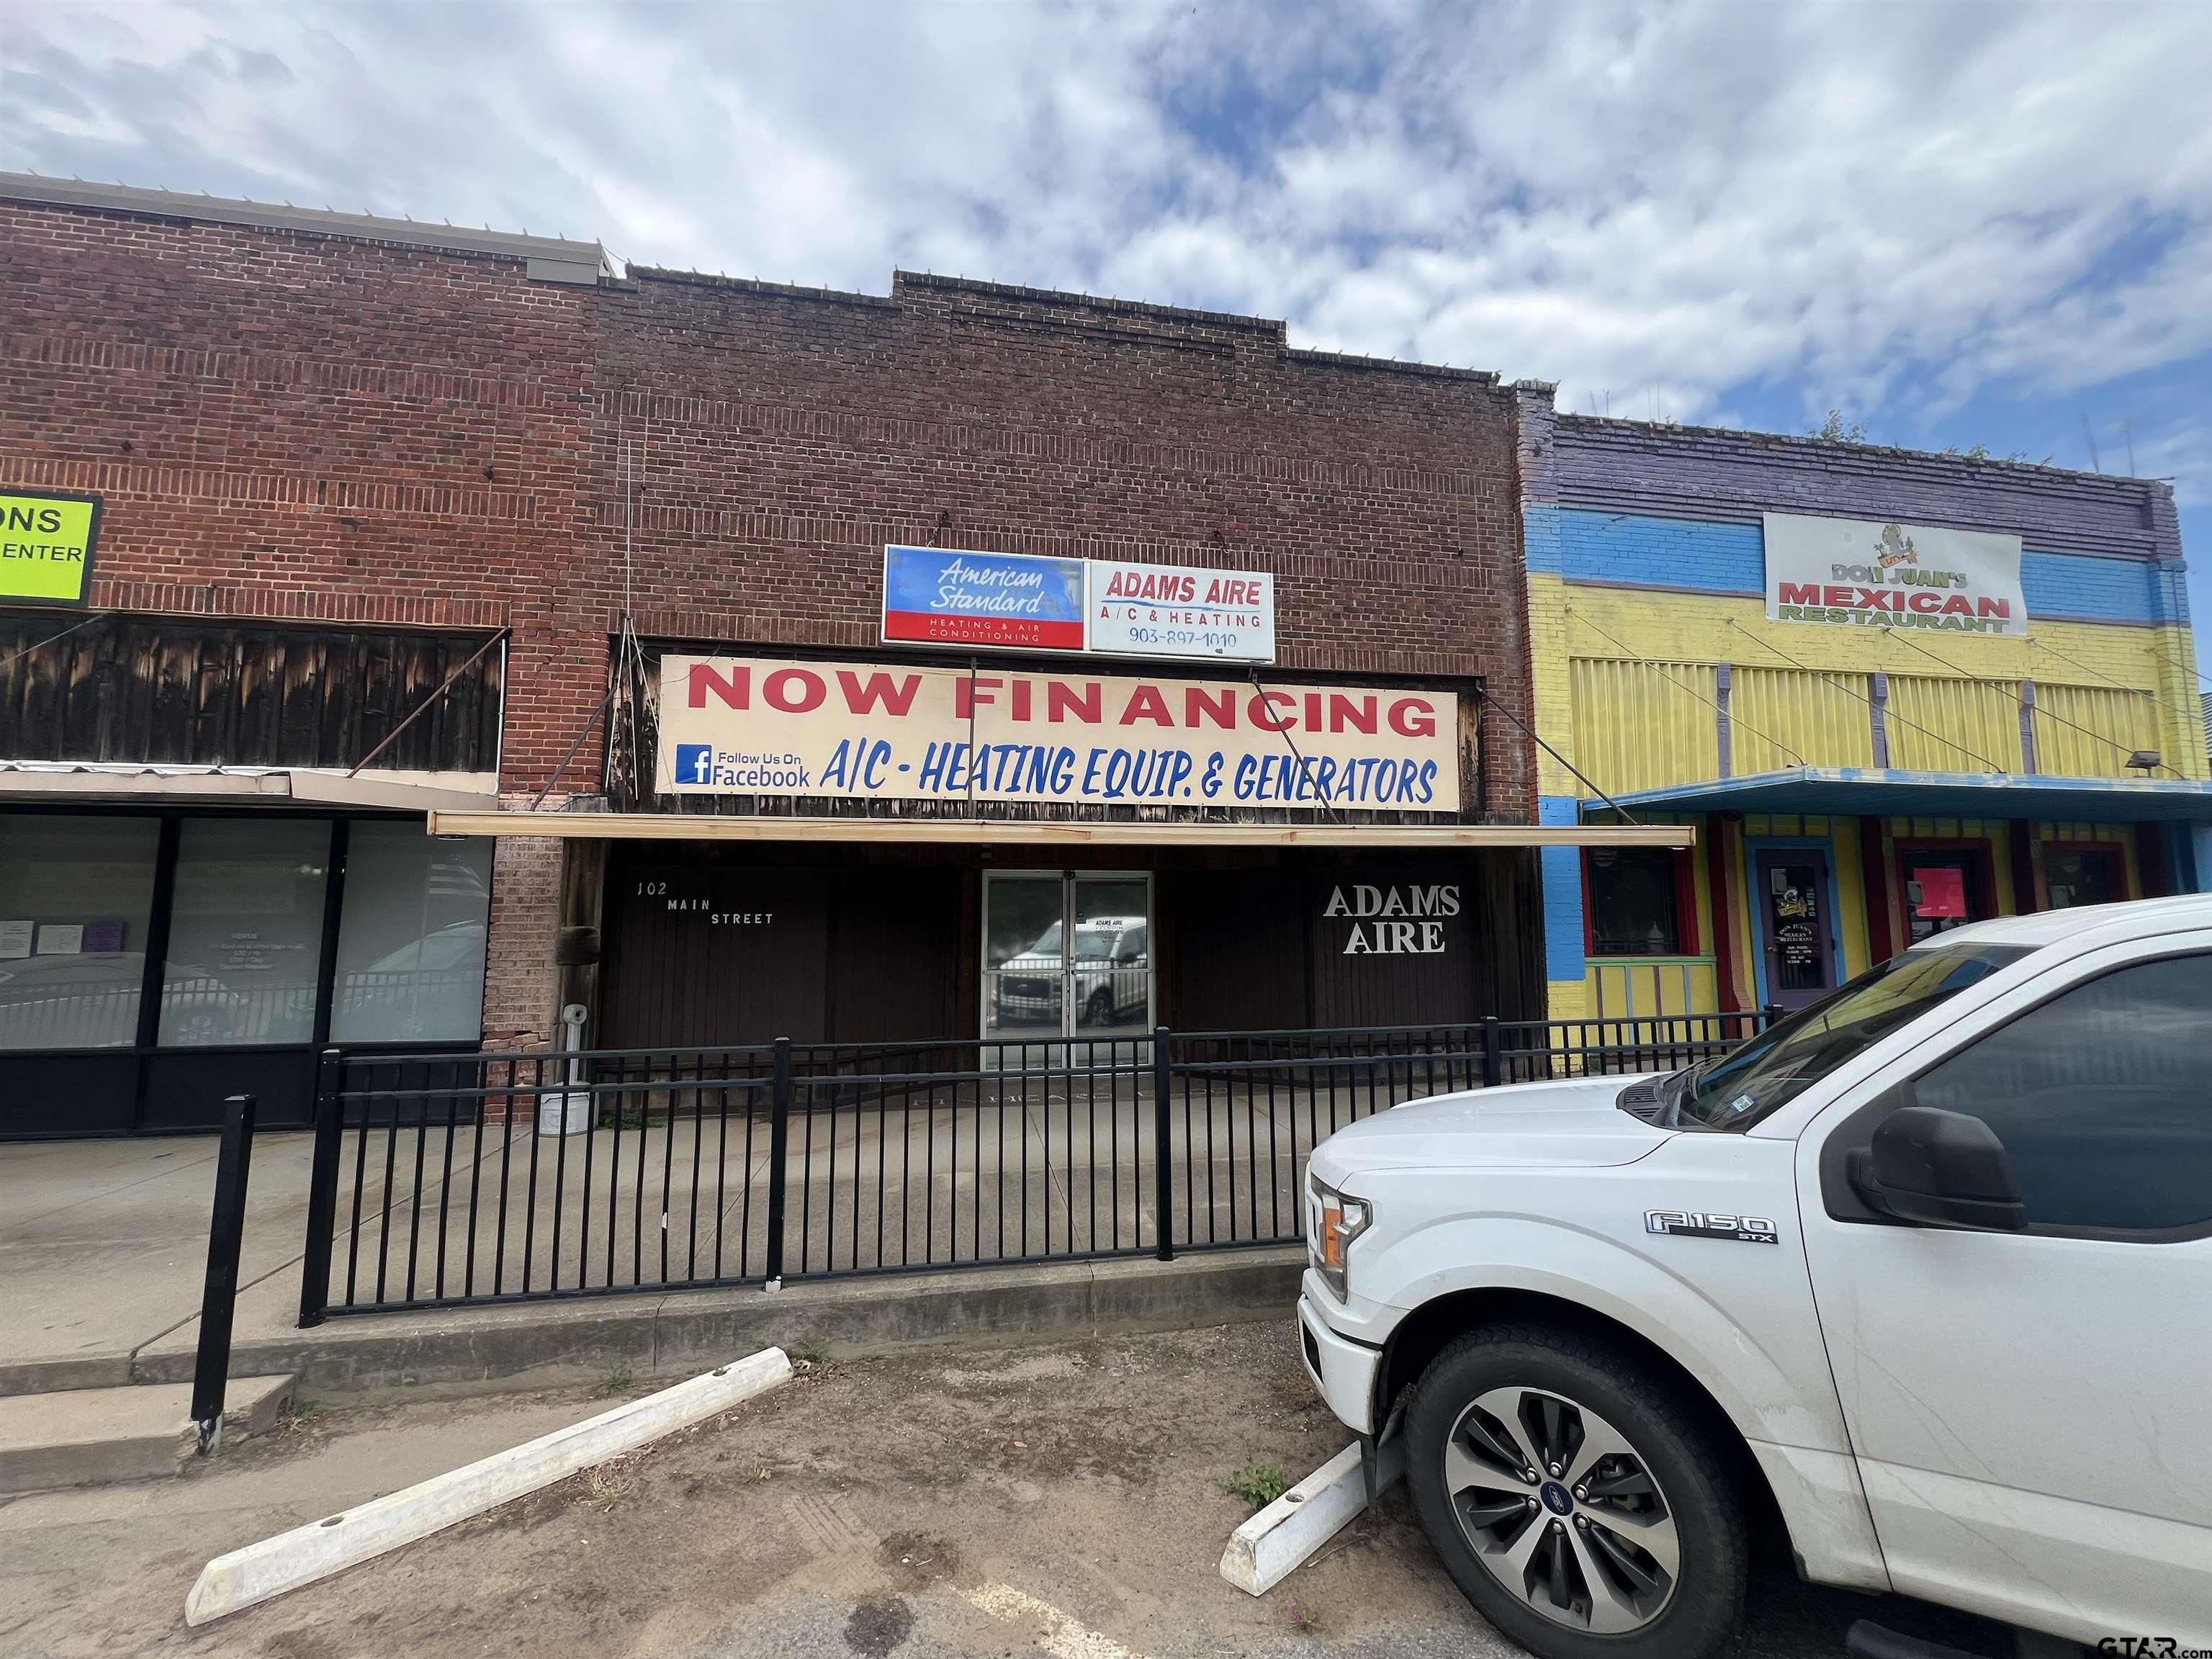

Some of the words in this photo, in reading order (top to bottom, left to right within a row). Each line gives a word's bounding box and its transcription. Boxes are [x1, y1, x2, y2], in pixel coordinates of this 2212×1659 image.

[0, 507, 61, 534] NS
[938, 557, 1043, 589] American
[1888, 567, 1967, 589] JUAN'S
[930, 585, 1045, 613] Standard
[1106, 571, 1195, 603] ADAMS
[1205, 579, 1262, 606] AIRE
[1779, 582, 2010, 619] MEXICAN
[930, 619, 992, 630] HEATING
[1018, 624, 1040, 632] AIR
[1149, 610, 1157, 622] &
[1169, 611, 1260, 628] HEATING
[1779, 605, 2010, 633] RESTAURANT
[929, 629, 1039, 642] CONDITIONING
[1129, 626, 1237, 647] 903-897-1010
[688, 664, 922, 716] NOW
[955, 677, 1436, 738] FINANCING
[719, 752, 760, 764] Follow
[763, 753, 780, 765] Us
[783, 754, 801, 765] On
[713, 765, 810, 787] Facebook
[819, 737, 891, 793] A/C
[919, 742, 1076, 796] HEATING
[1200, 750, 1224, 797] &
[1233, 753, 1437, 805] GENERATORS
[637, 882, 667, 896] 102
[667, 899, 709, 910] MAIN
[1323, 885, 1460, 917] ADAMS
[711, 914, 773, 924] STREET
[1343, 922, 1445, 954] AIRE
[1738, 1233, 1773, 1242] STX
